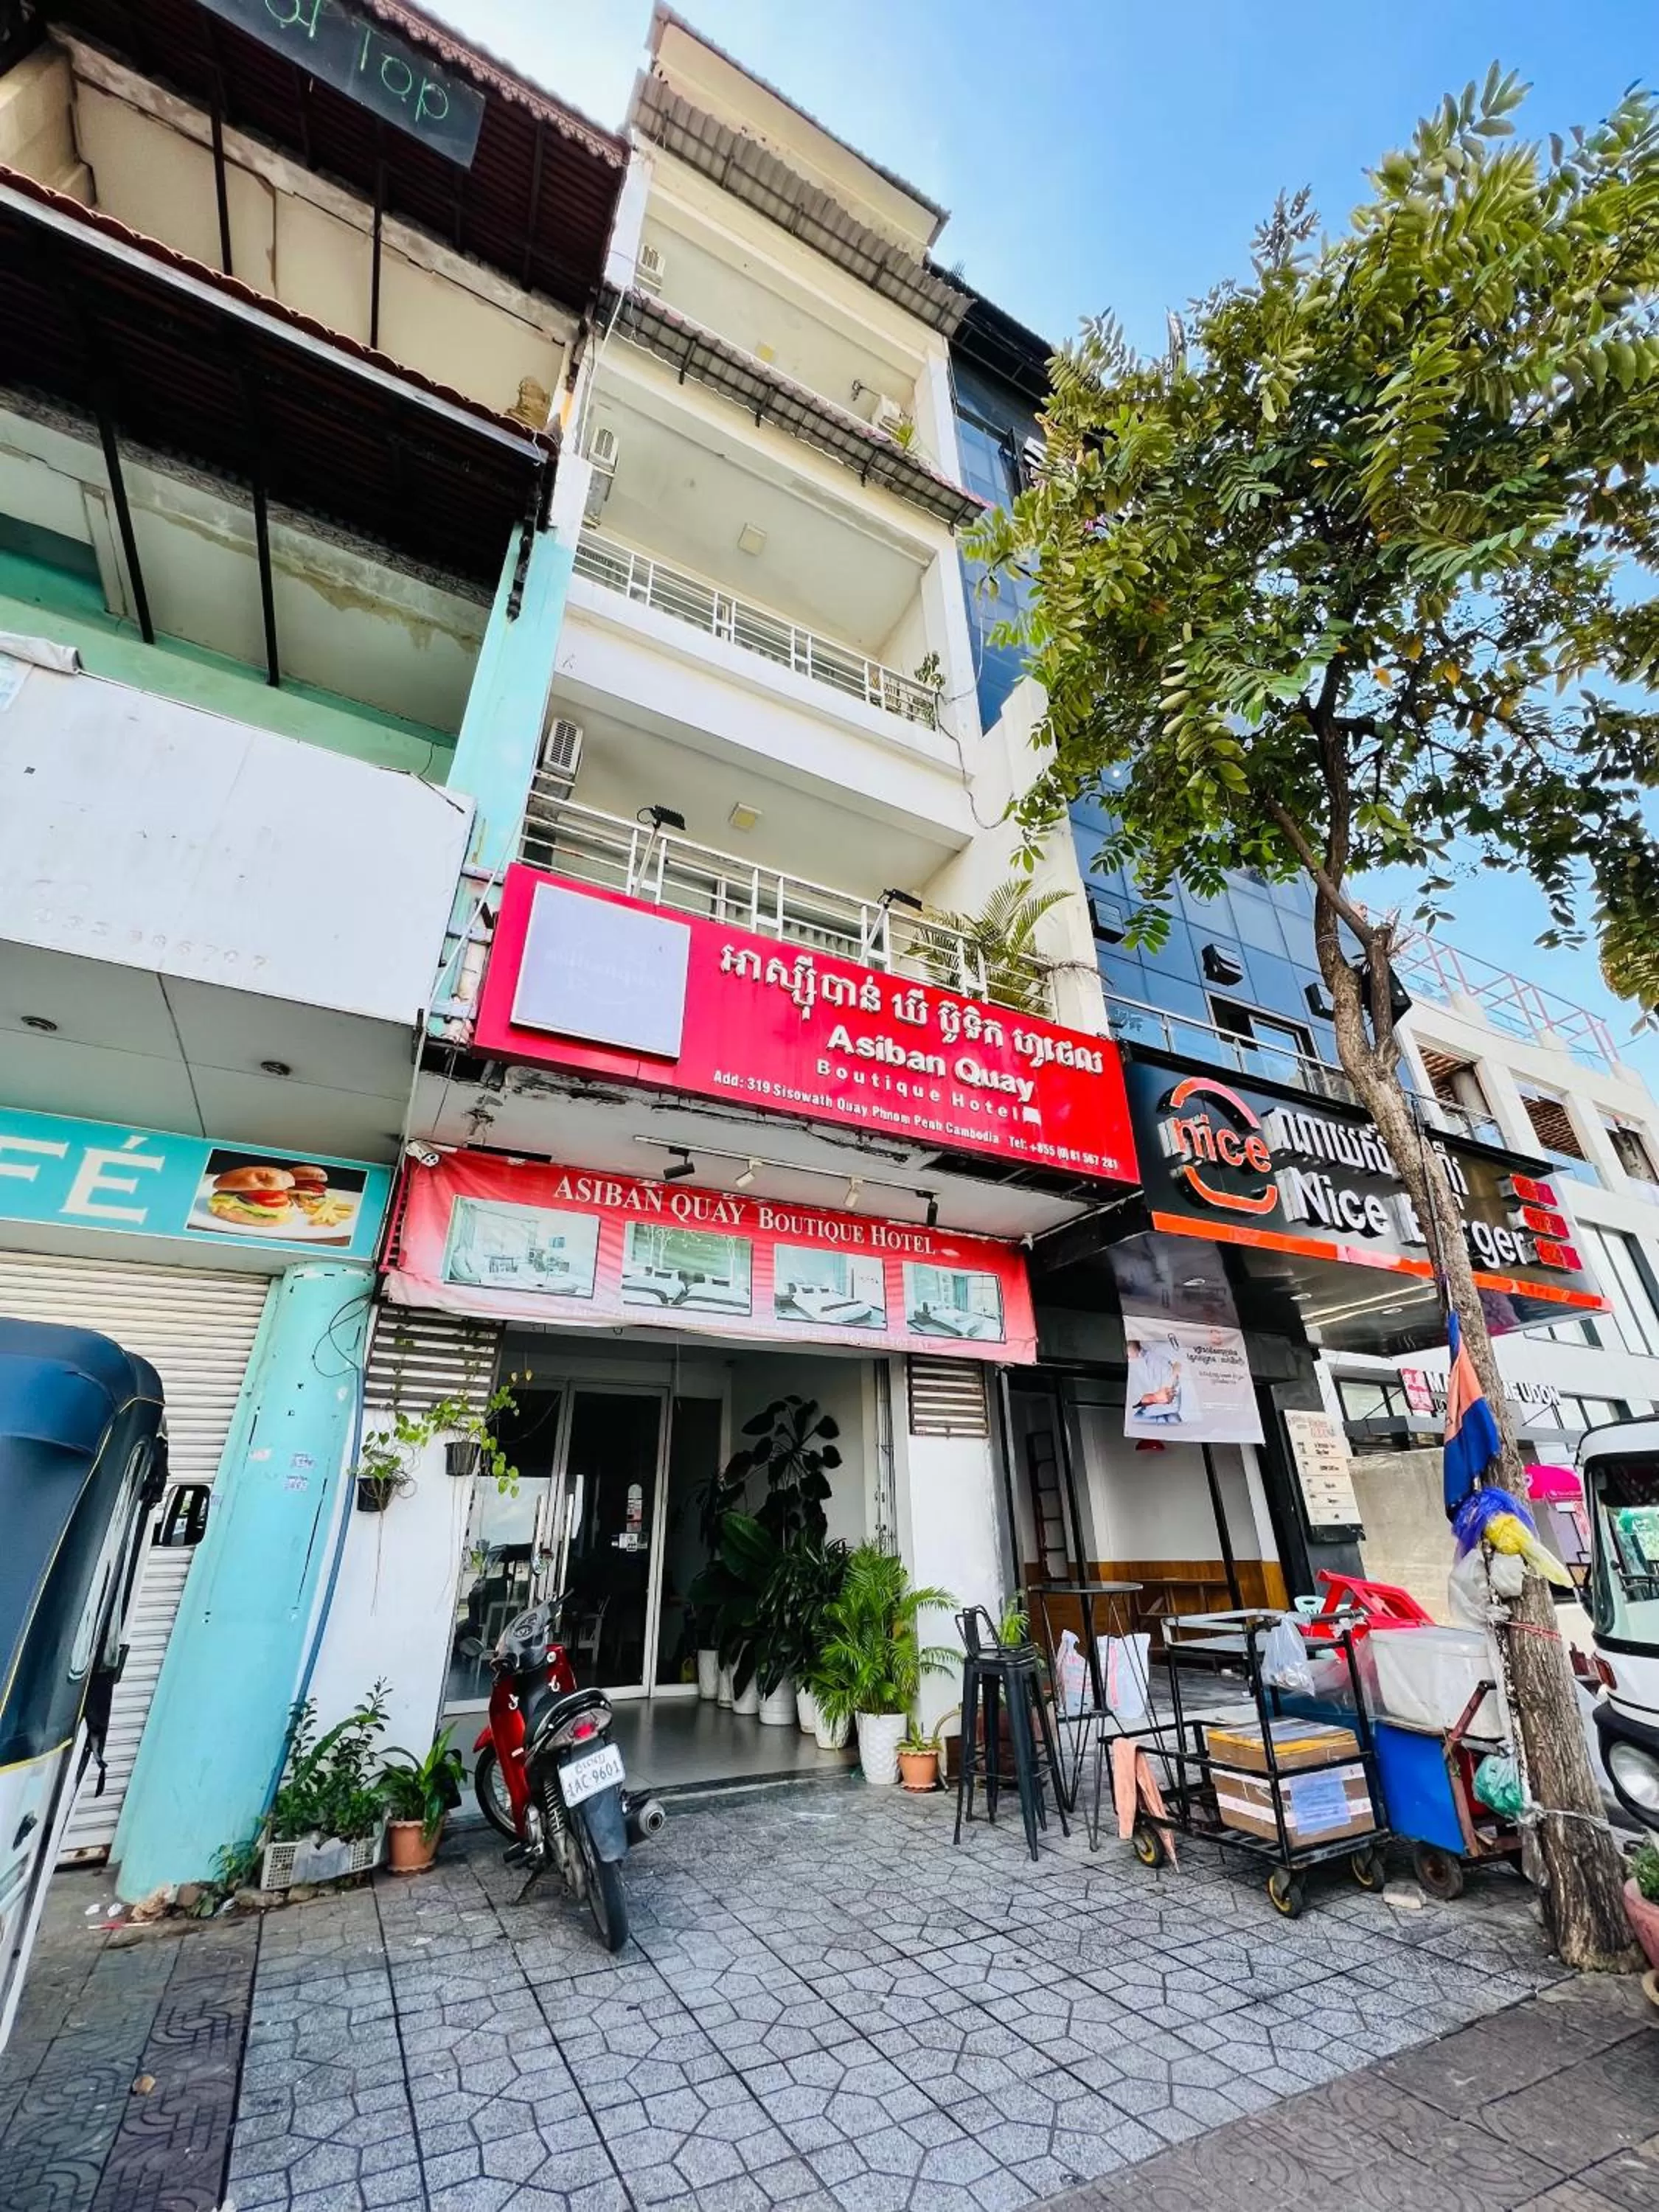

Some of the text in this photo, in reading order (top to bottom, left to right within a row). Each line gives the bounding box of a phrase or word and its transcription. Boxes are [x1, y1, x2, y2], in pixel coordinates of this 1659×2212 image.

[816, 1058, 1018, 1121] Boutique Hotel
[826, 1024, 1036, 1103] Asiban Quay
[713, 1069, 744, 1088] Add:
[747, 1077, 771, 1093] 319
[773, 1083, 833, 1108] Sisowath
[837, 1096, 869, 1118] Quay
[872, 1105, 911, 1125] Phnom
[914, 1114, 943, 1132] Penh
[945, 1121, 1000, 1144] Cambodia
[1008, 1135, 1028, 1151] Tel:
[1172, 1113, 1271, 1174] nice
[554, 1175, 664, 1213] ASIBAN
[670, 1193, 746, 1225] QUAY
[1283, 1166, 1391, 1236] Nice
[1519, 1381, 1562, 1406] UDON
